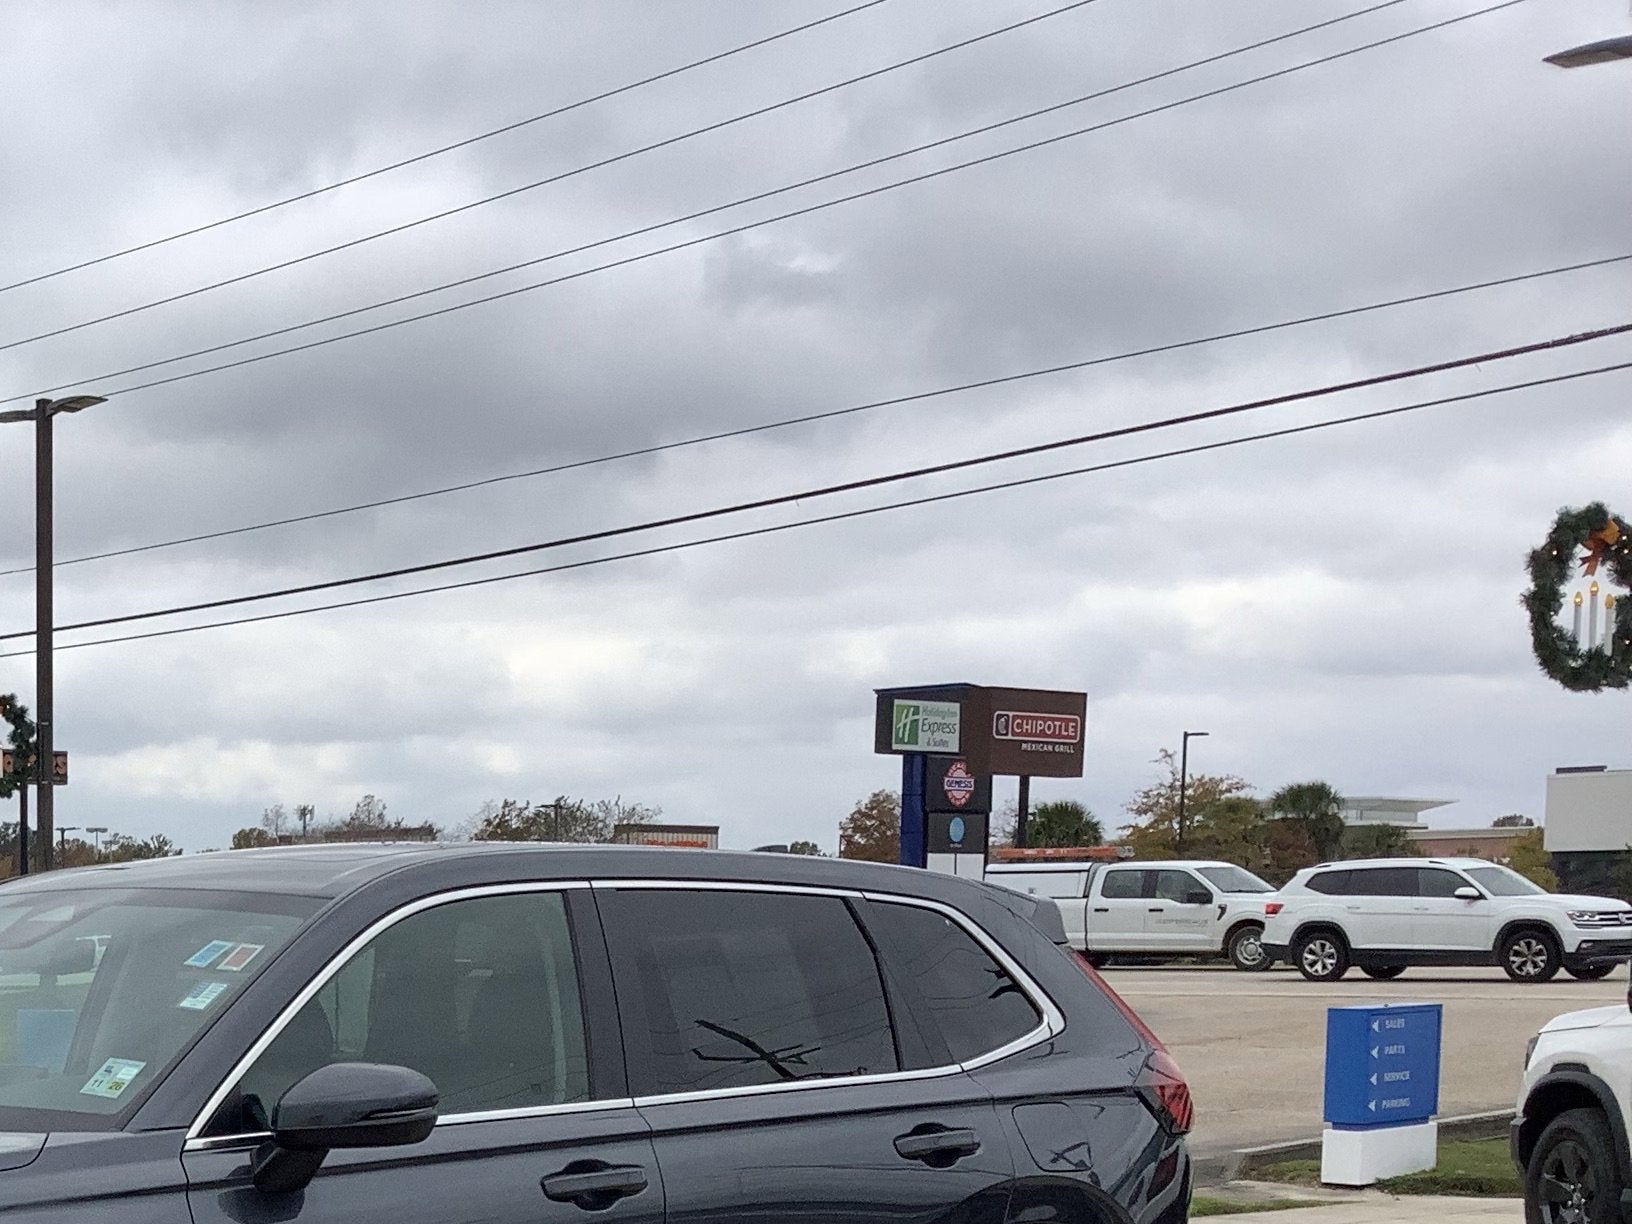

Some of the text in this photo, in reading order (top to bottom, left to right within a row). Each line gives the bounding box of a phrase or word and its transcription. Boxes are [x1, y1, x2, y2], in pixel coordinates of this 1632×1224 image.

[921, 717, 957, 736] Express
[1013, 719, 1076, 737] CHIPOTLE
[1021, 742, 1075, 753] MEXICAN GRILL
[1383, 1070, 1410, 1082] SERVICE
